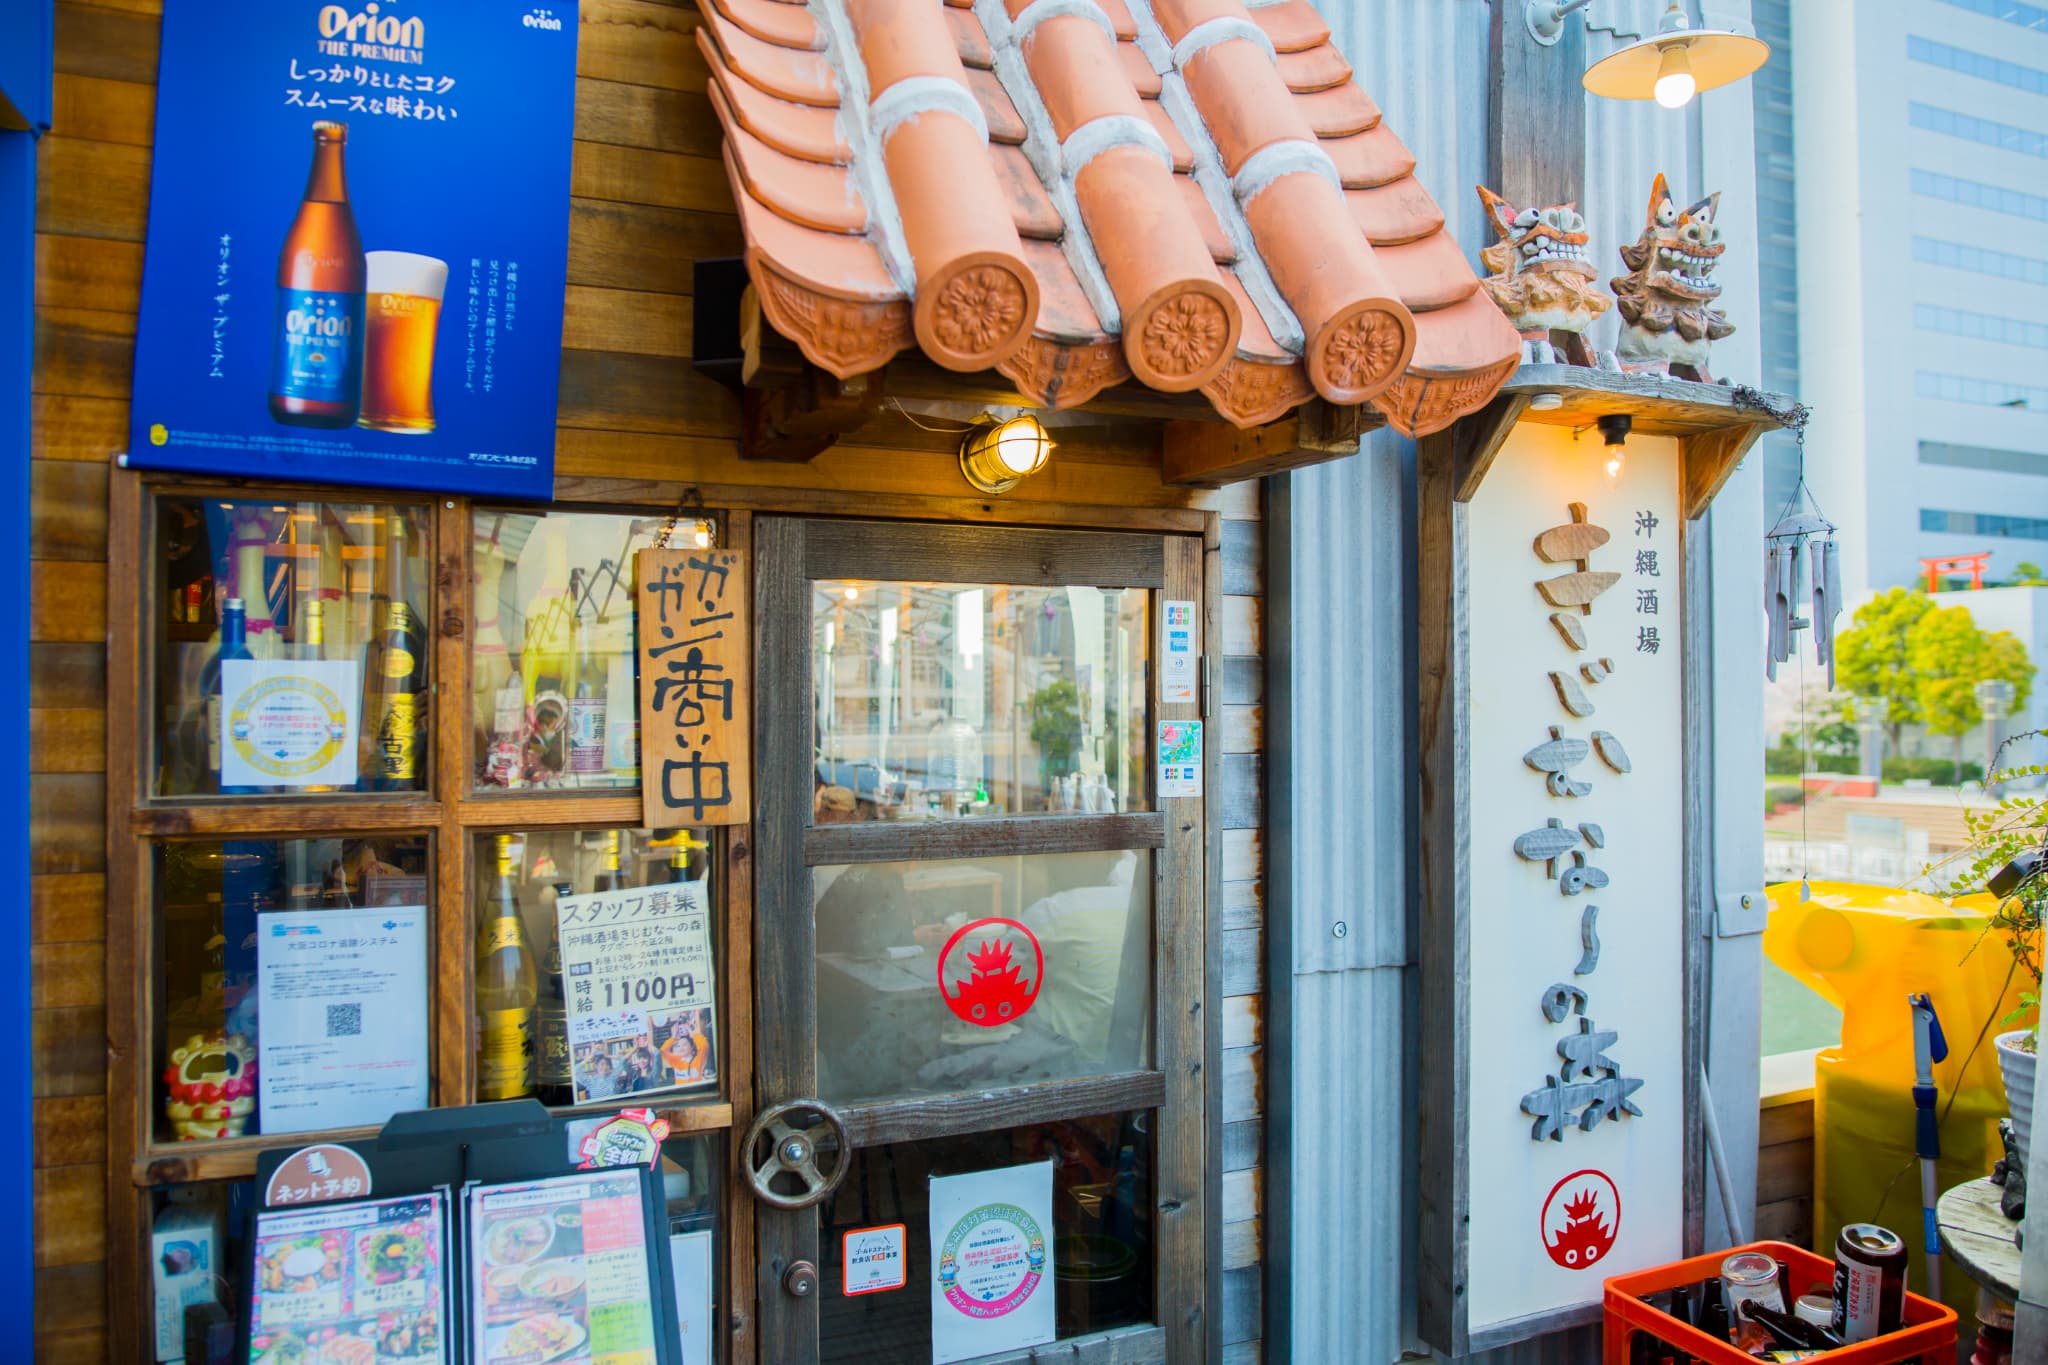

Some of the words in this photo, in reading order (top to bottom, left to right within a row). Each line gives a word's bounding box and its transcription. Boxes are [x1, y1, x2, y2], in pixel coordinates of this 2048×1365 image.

[318, 2, 424, 49] Orion
[523, 14, 562, 31] Orion
[317, 40, 348, 57] THE
[352, 43, 423, 65] PREMIUM
[290, 58, 456, 95] しっかりとしたコク
[284, 89, 458, 121] スムースな味わい
[286, 308, 352, 337] Orion
[1634, 510, 1661, 655] 沖縄酒場
[562, 889, 698, 925] スタッフ募集
[575, 980, 593, 1013] 時給
[275, 1176, 363, 1202] ネット予約
